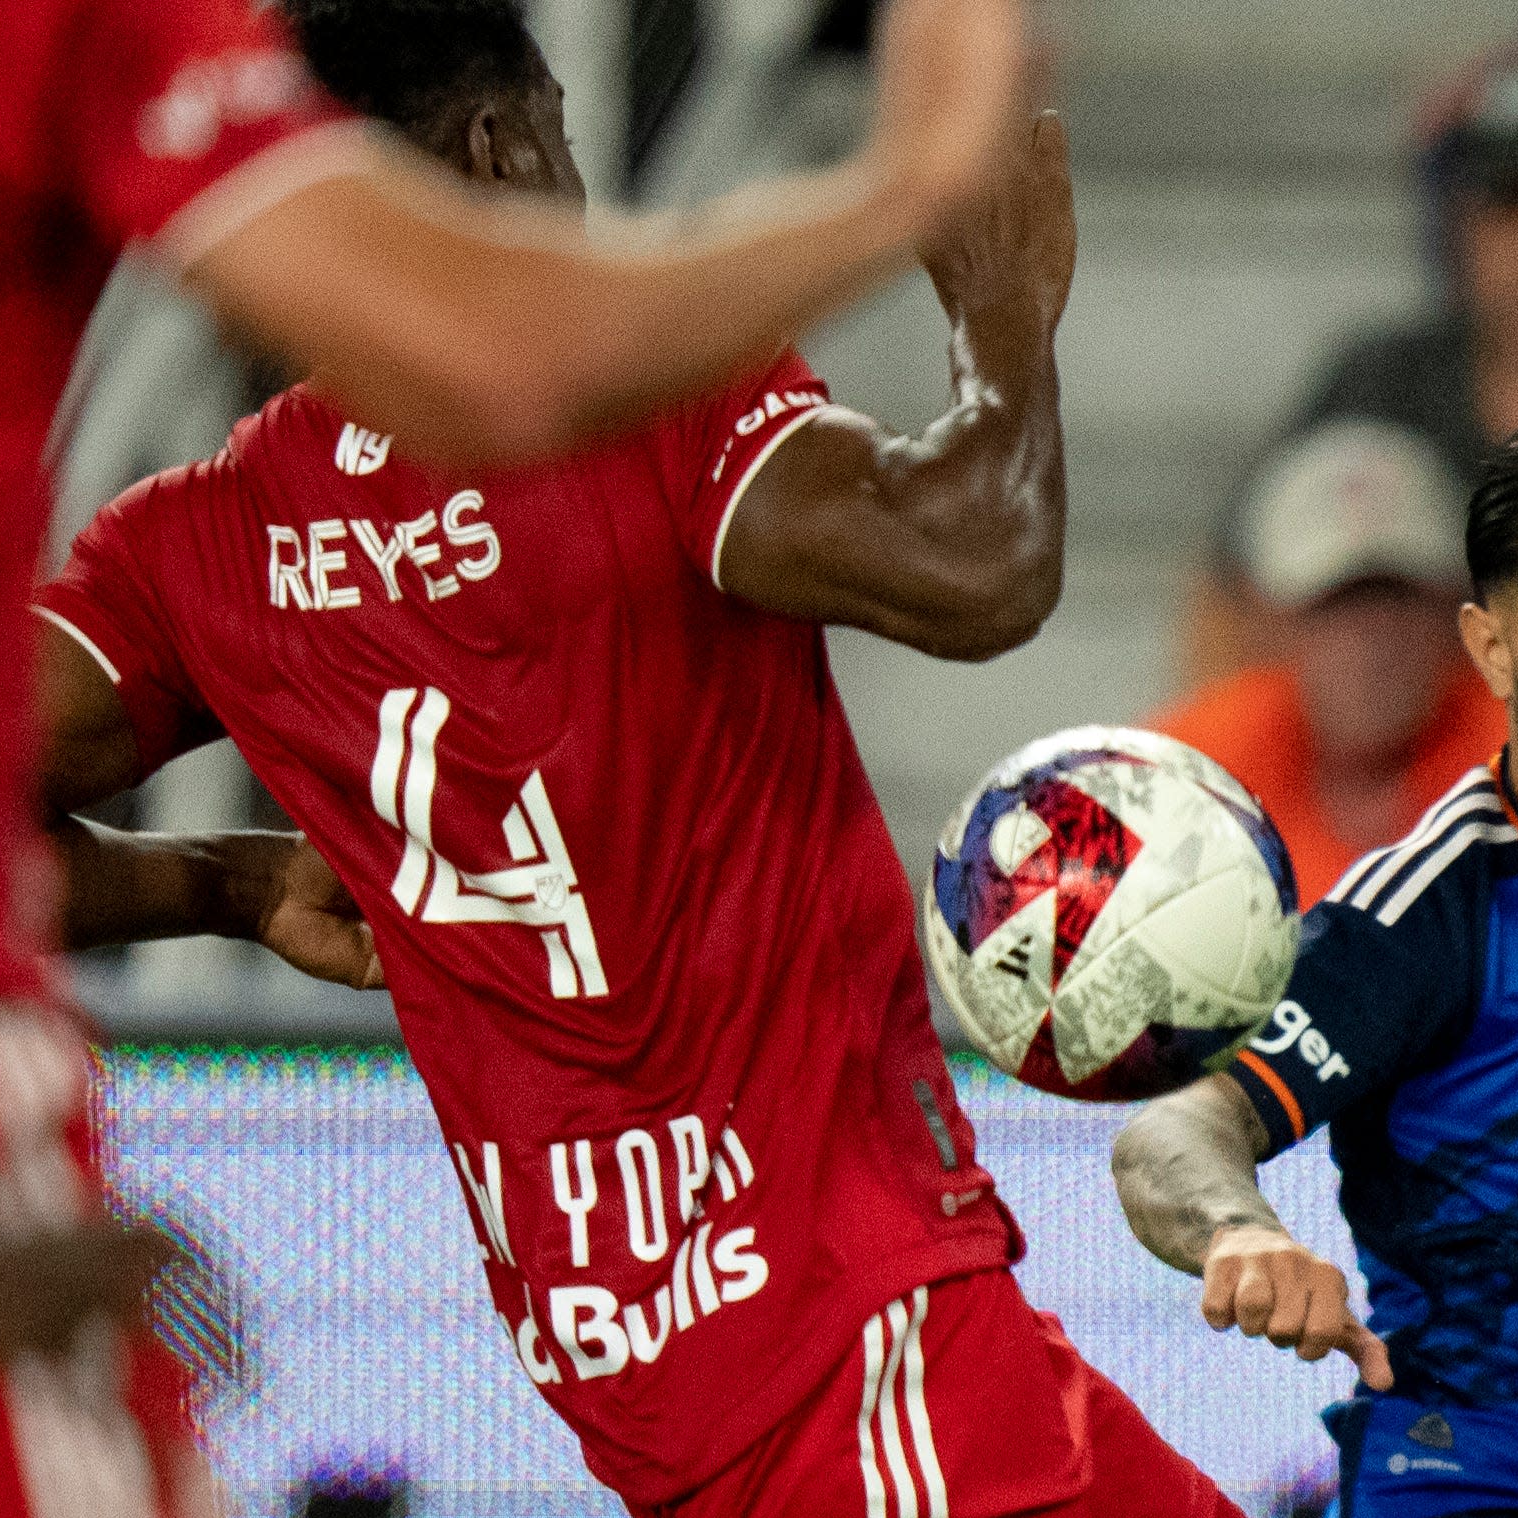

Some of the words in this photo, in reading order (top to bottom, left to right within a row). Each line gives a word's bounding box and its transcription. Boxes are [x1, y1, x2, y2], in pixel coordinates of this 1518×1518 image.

[334, 422, 395, 476] NY
[267, 489, 502, 611] REYES
[370, 686, 609, 999] 4
[549, 1222, 770, 1382] Bulls
